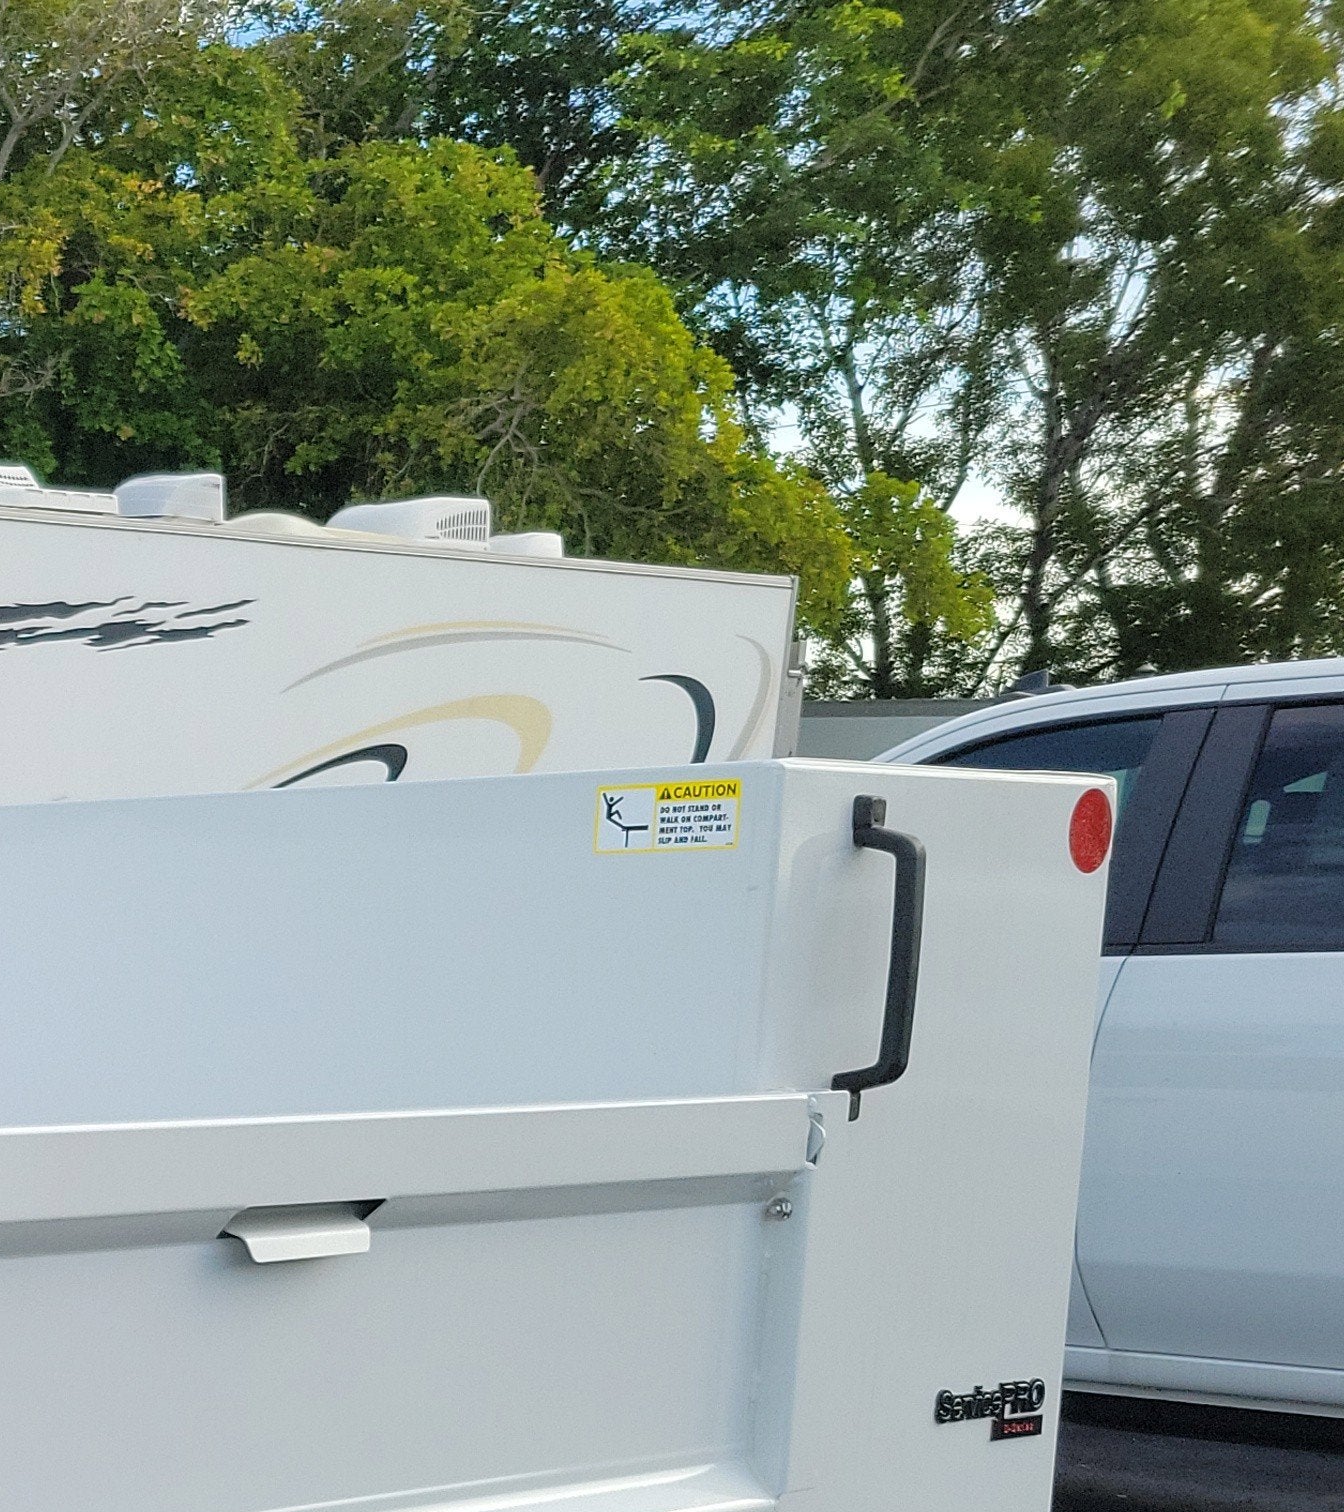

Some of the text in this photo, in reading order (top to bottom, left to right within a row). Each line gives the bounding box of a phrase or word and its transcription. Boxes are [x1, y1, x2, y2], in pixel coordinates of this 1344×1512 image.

[673, 784, 737, 798] CAUTION
[660, 806, 670, 814] DO
[672, 805, 686, 813] NOT
[687, 804, 709, 812] STAND
[660, 813, 729, 824] WALK ON COMPART-
[659, 826, 678, 834] MENT
[715, 824, 732, 832] MAY
